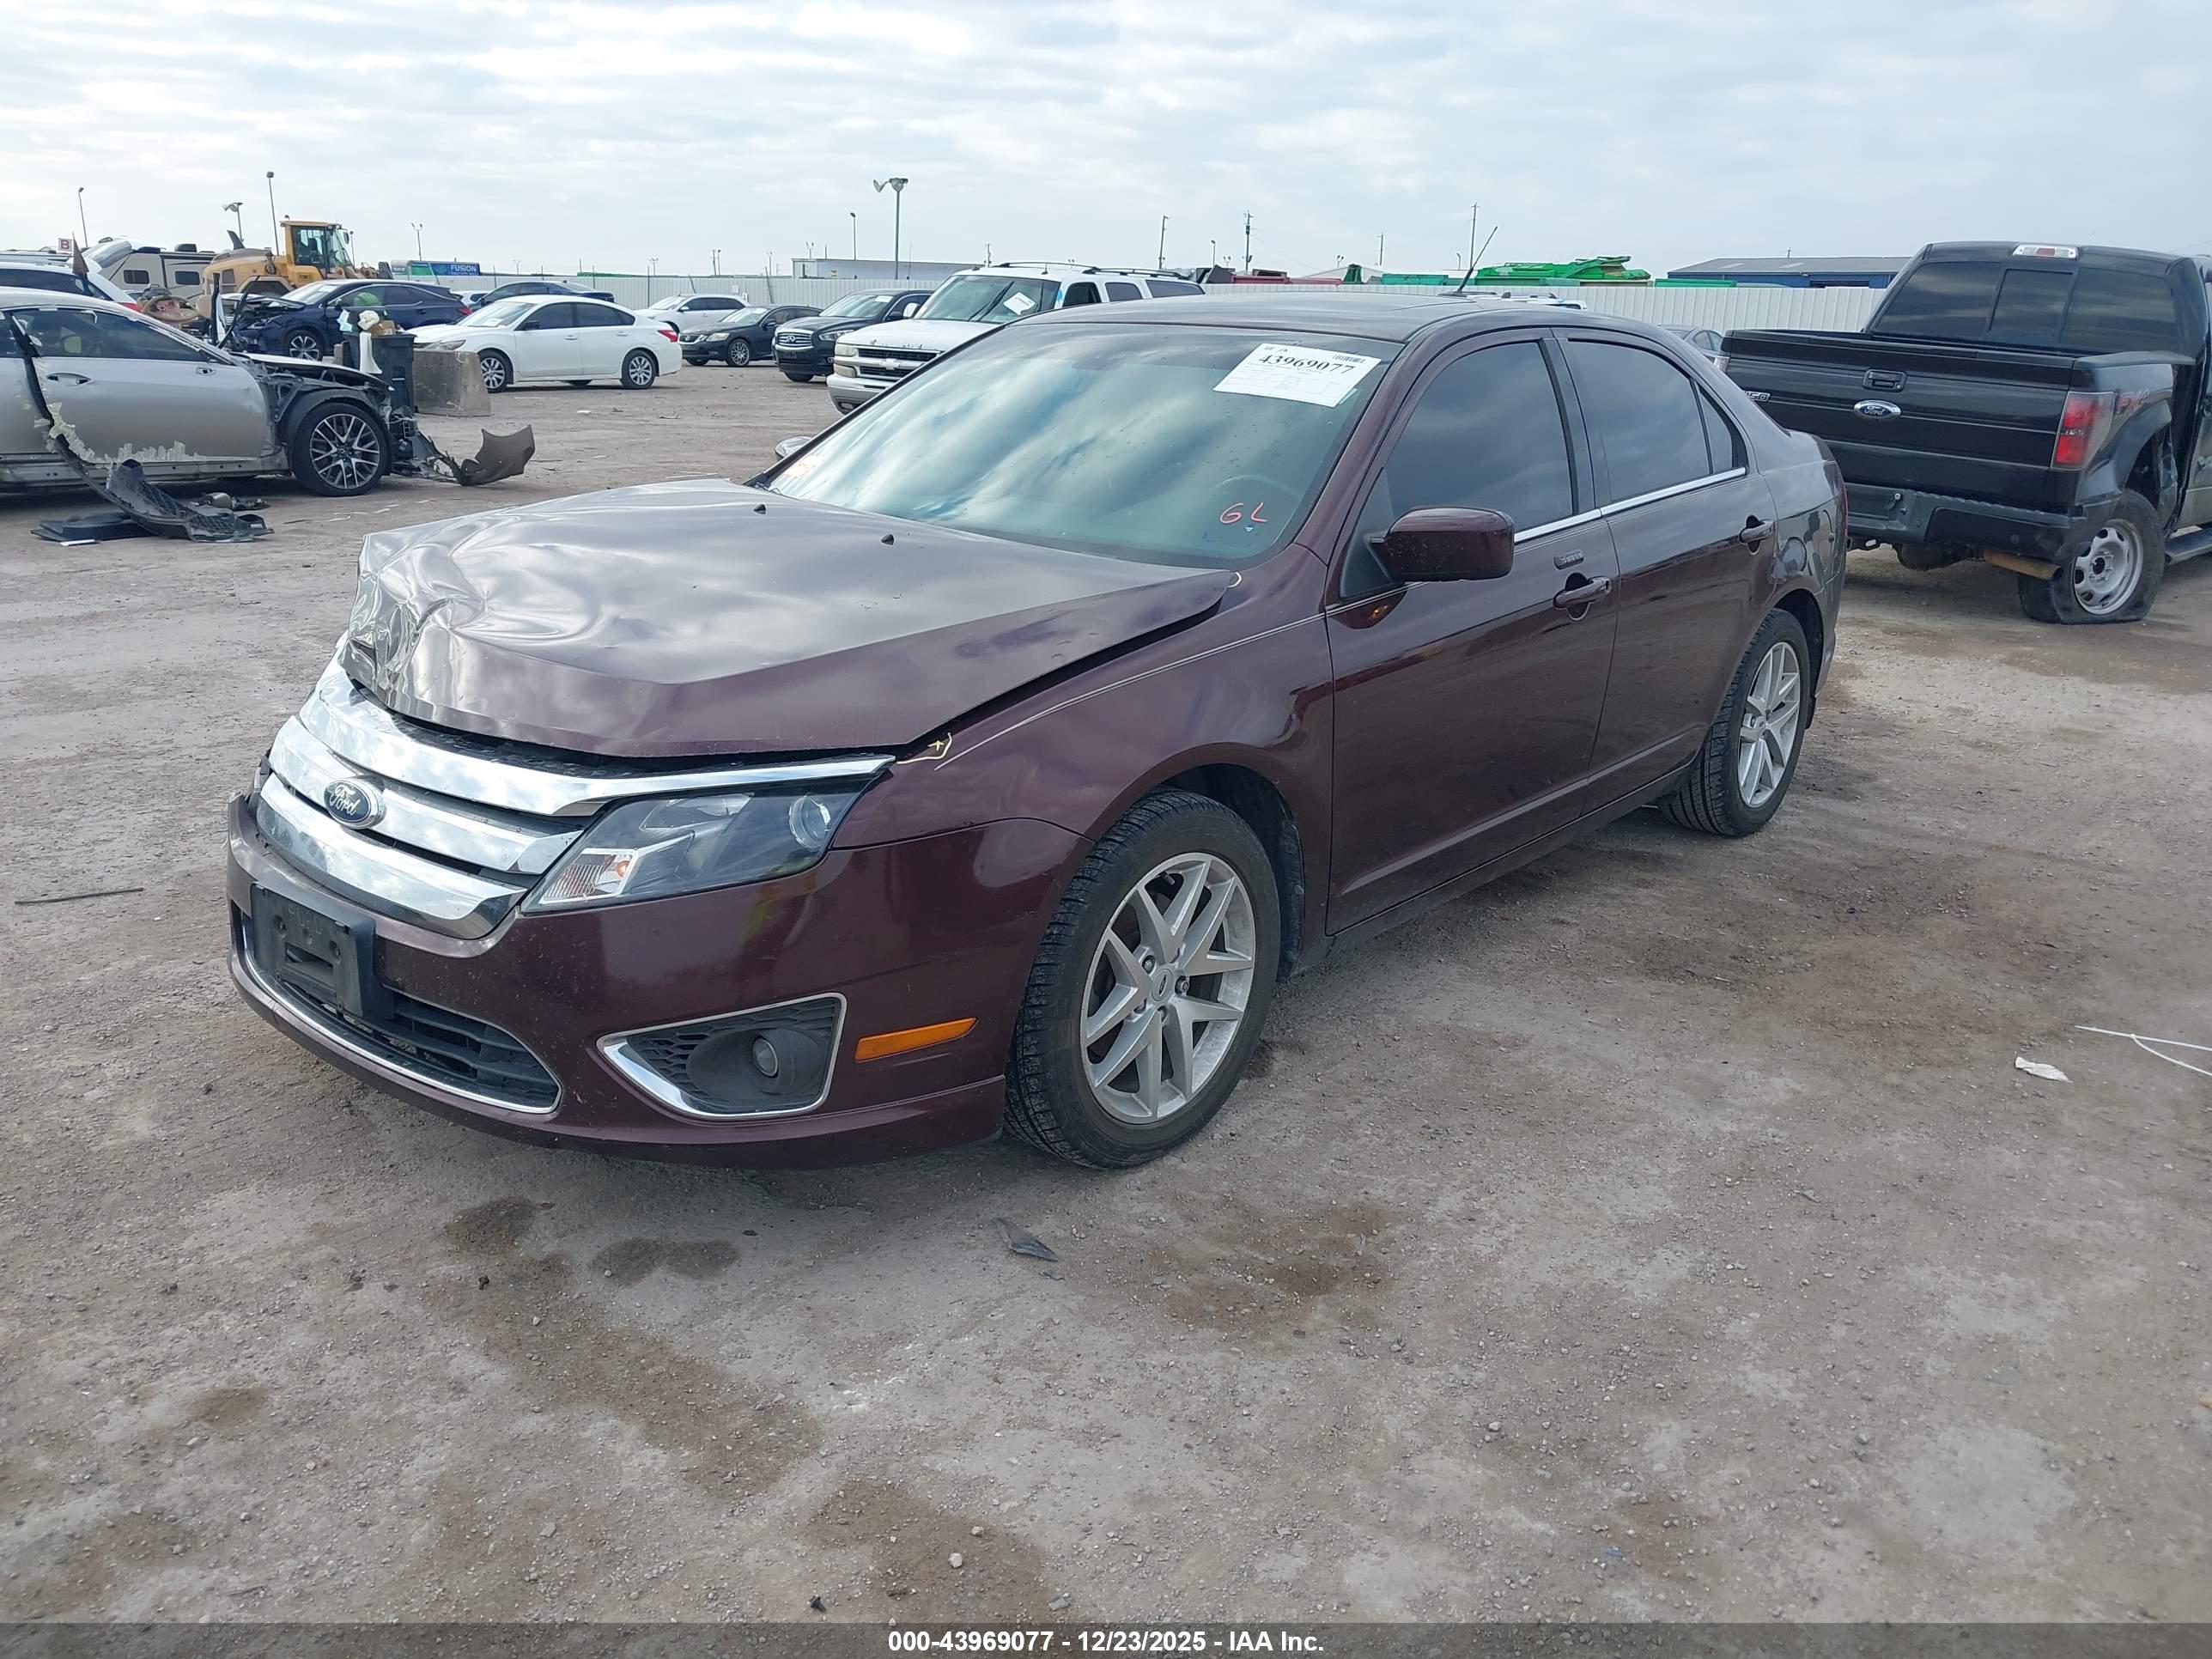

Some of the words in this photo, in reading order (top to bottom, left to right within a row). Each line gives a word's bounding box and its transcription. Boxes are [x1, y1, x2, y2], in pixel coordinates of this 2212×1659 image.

[60, 240, 70, 250] B
[450, 264, 477, 272] FUSION
[1258, 354, 1356, 374] 43969077
[1864, 405, 1886, 416] Ford
[329, 783, 362, 817] Ford
